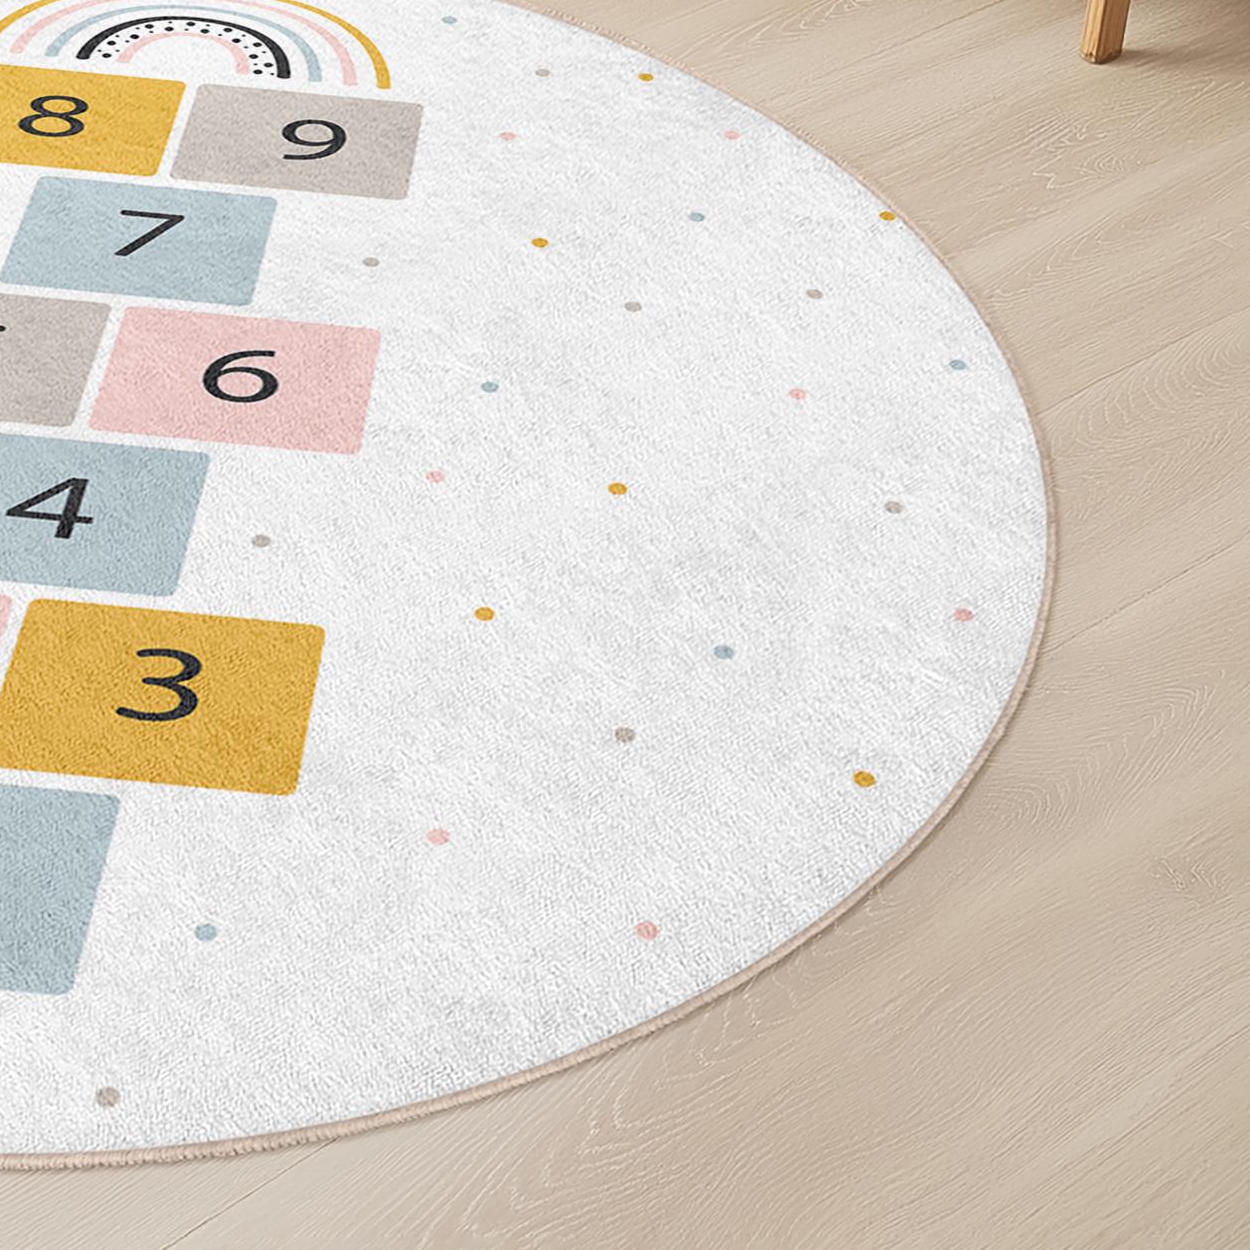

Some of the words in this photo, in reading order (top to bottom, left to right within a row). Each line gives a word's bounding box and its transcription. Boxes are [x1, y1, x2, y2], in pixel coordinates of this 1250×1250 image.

[18, 95, 89, 138] 8
[281, 119, 347, 161] 9
[114, 209, 185, 257] 7
[202, 350, 279, 403] 6
[5, 477, 94, 540] 4
[115, 648, 203, 723] 3
